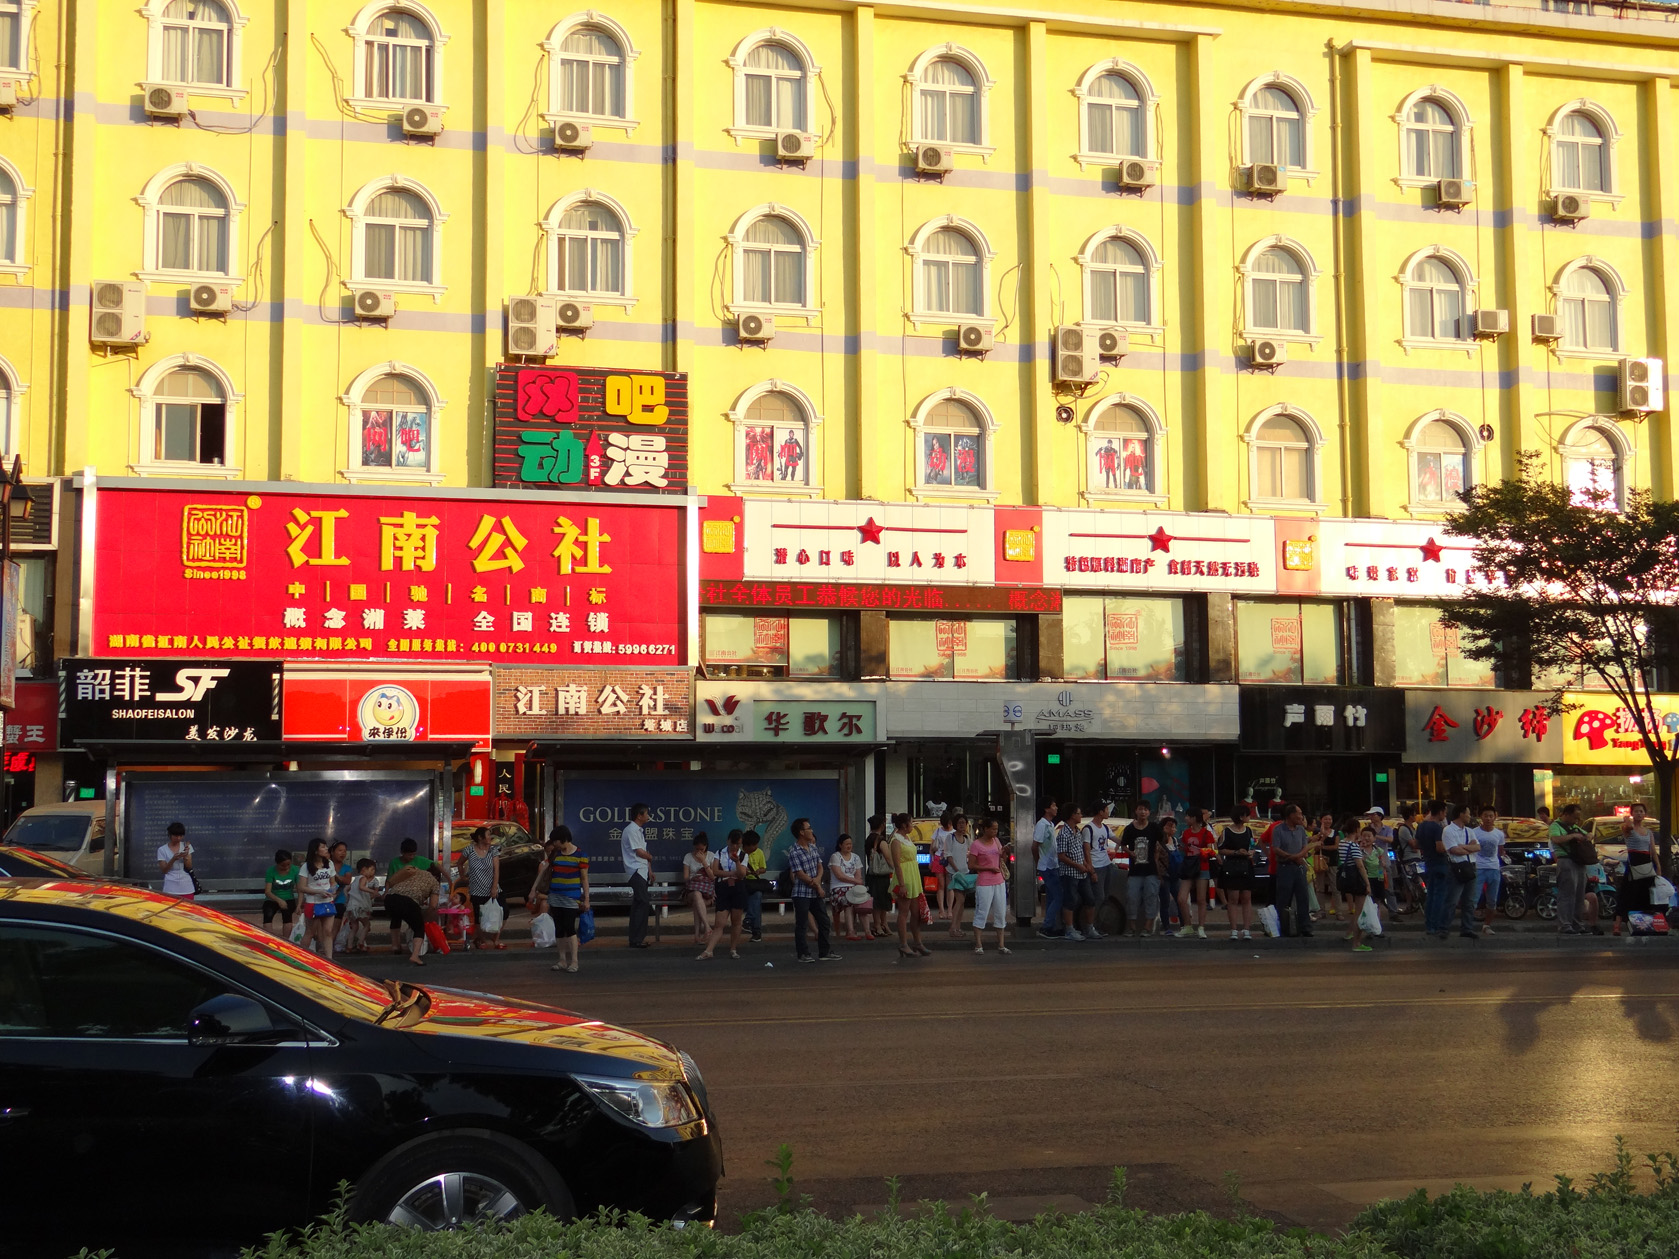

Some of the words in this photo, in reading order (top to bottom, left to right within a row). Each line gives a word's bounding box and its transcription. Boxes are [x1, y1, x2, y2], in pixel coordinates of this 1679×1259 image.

[518, 369, 669, 425] 网吧
[518, 430, 669, 487] 动漫
[589, 455, 600, 480] 3F
[286, 507, 612, 575] 江南公社
[888, 551, 967, 570] 以人为本
[474, 611, 609, 634] 全国连锁
[472, 642, 496, 653] 400
[500, 642, 530, 653] 0731
[532, 643, 558, 654] 449
[76, 668, 151, 701] 韶菲
[515, 683, 671, 715] 江南公社
[112, 709, 195, 719] SHAOFEISALON
[764, 711, 863, 737] 华歌尔
[1036, 709, 1093, 718] AMASS
[1422, 705, 1550, 742] 金沙缔
[185, 725, 258, 742] 美发沙龙
[608, 827, 699, 841] 金盟珠宝
